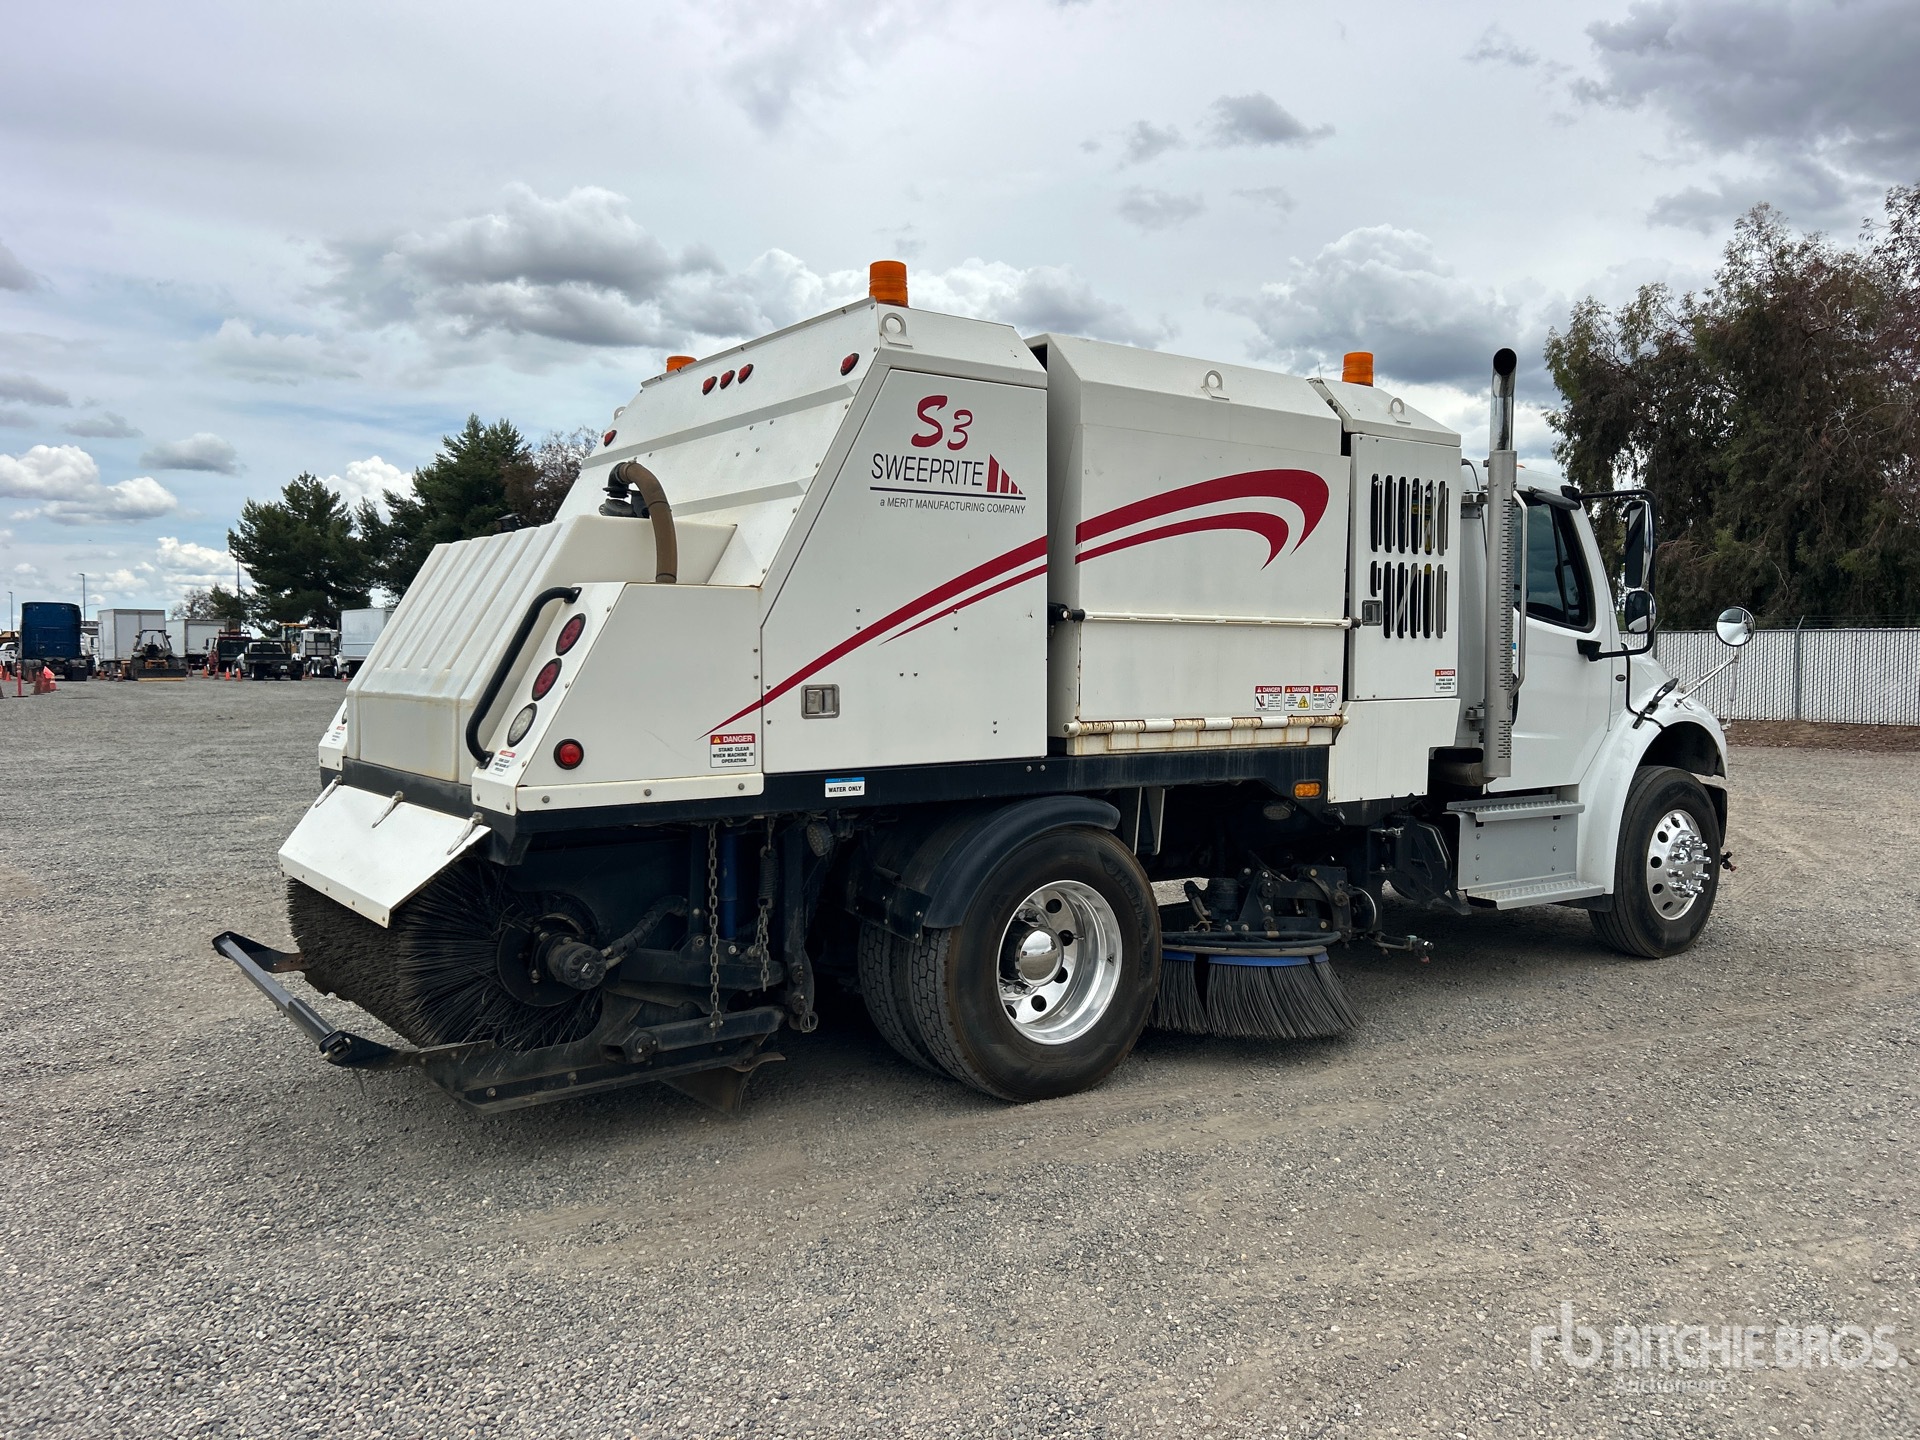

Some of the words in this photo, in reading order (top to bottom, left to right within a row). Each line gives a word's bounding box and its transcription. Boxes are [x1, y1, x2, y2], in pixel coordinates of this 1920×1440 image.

[911, 395, 973, 451] S3
[871, 453, 985, 486] SWEEPRITE
[887, 497, 914, 509] MERIT
[915, 499, 985, 513] MANUFACTURING
[986, 503, 1026, 515] COMPANY
[723, 735, 753, 743] DANGER
